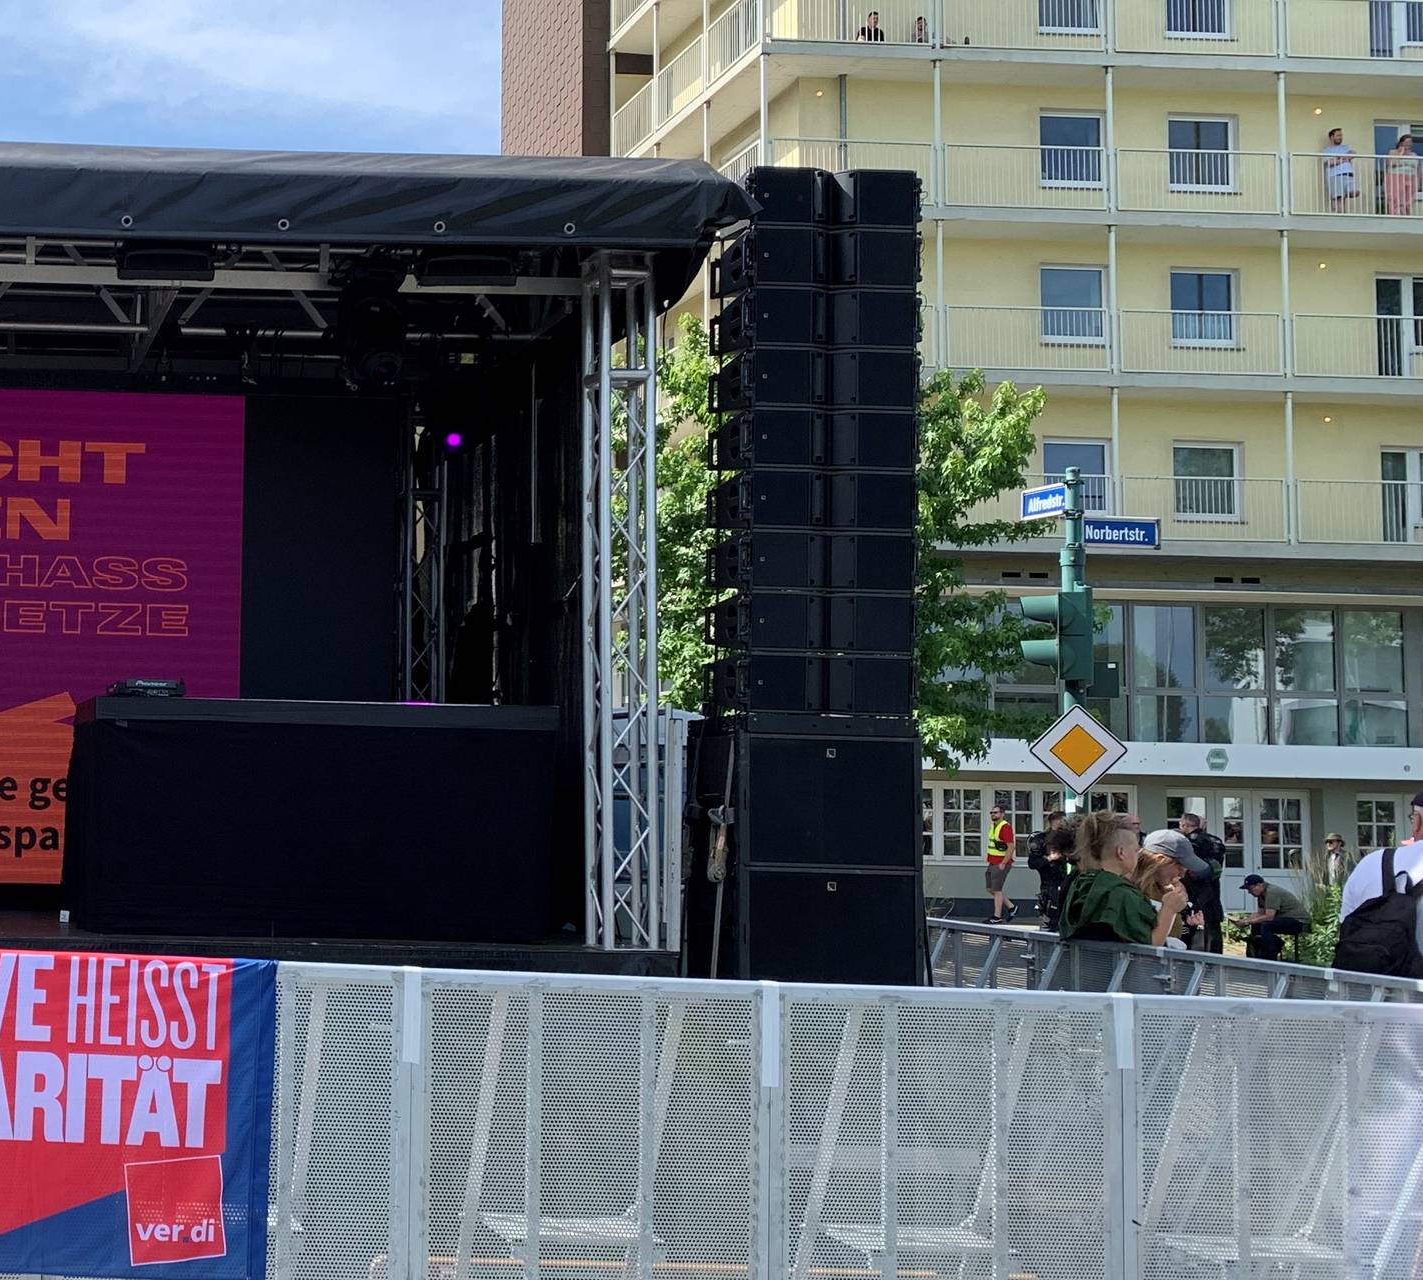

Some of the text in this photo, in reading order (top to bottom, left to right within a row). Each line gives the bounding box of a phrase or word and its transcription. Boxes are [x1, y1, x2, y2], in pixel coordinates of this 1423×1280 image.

[1027, 494, 1065, 513] Alfredstr.
[1085, 524, 1149, 542] Norbertstr.
[67, 956, 227, 1050] HEISST
[136, 1218, 215, 1243] ver.di
